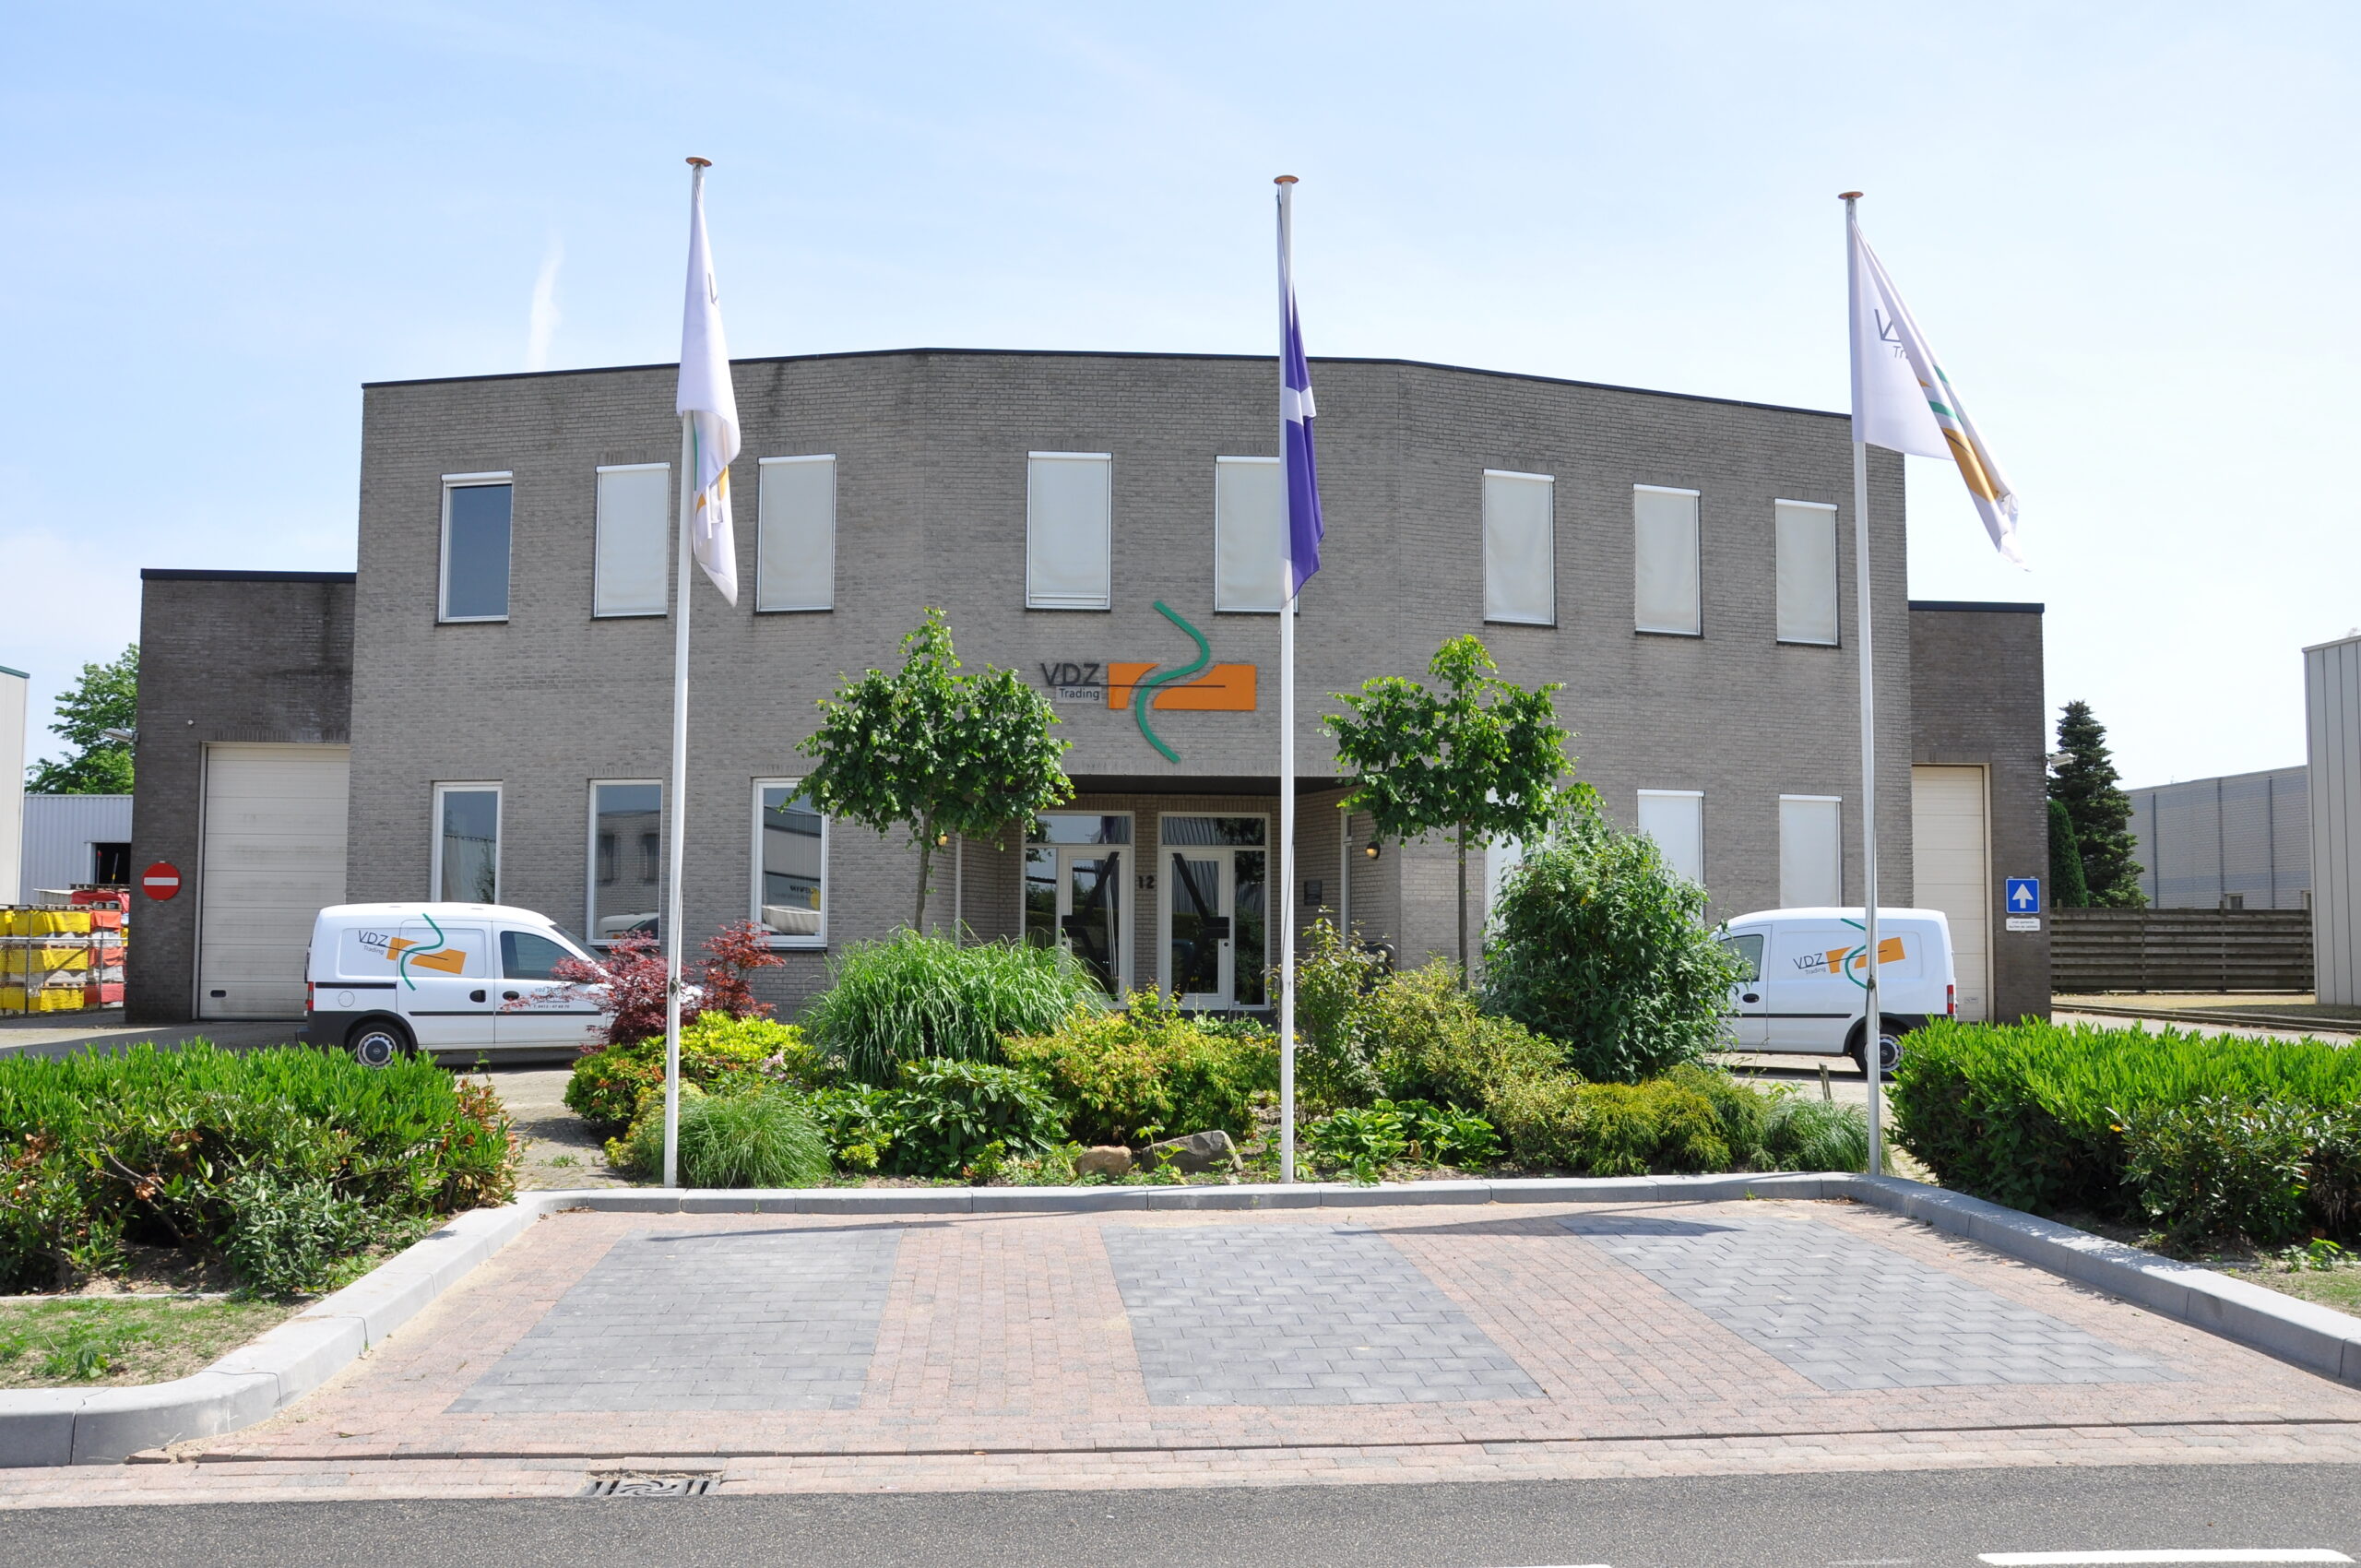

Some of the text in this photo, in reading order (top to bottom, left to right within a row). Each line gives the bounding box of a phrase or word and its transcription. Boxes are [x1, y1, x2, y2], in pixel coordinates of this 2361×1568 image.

[1040, 662, 1100, 686] VDZ
[1059, 687, 1100, 701] Trading
[1138, 875, 1155, 889] 12
[359, 930, 389, 947] VDZ
[363, 945, 385, 956] Trading
[1793, 952, 1822, 969] VDZ
